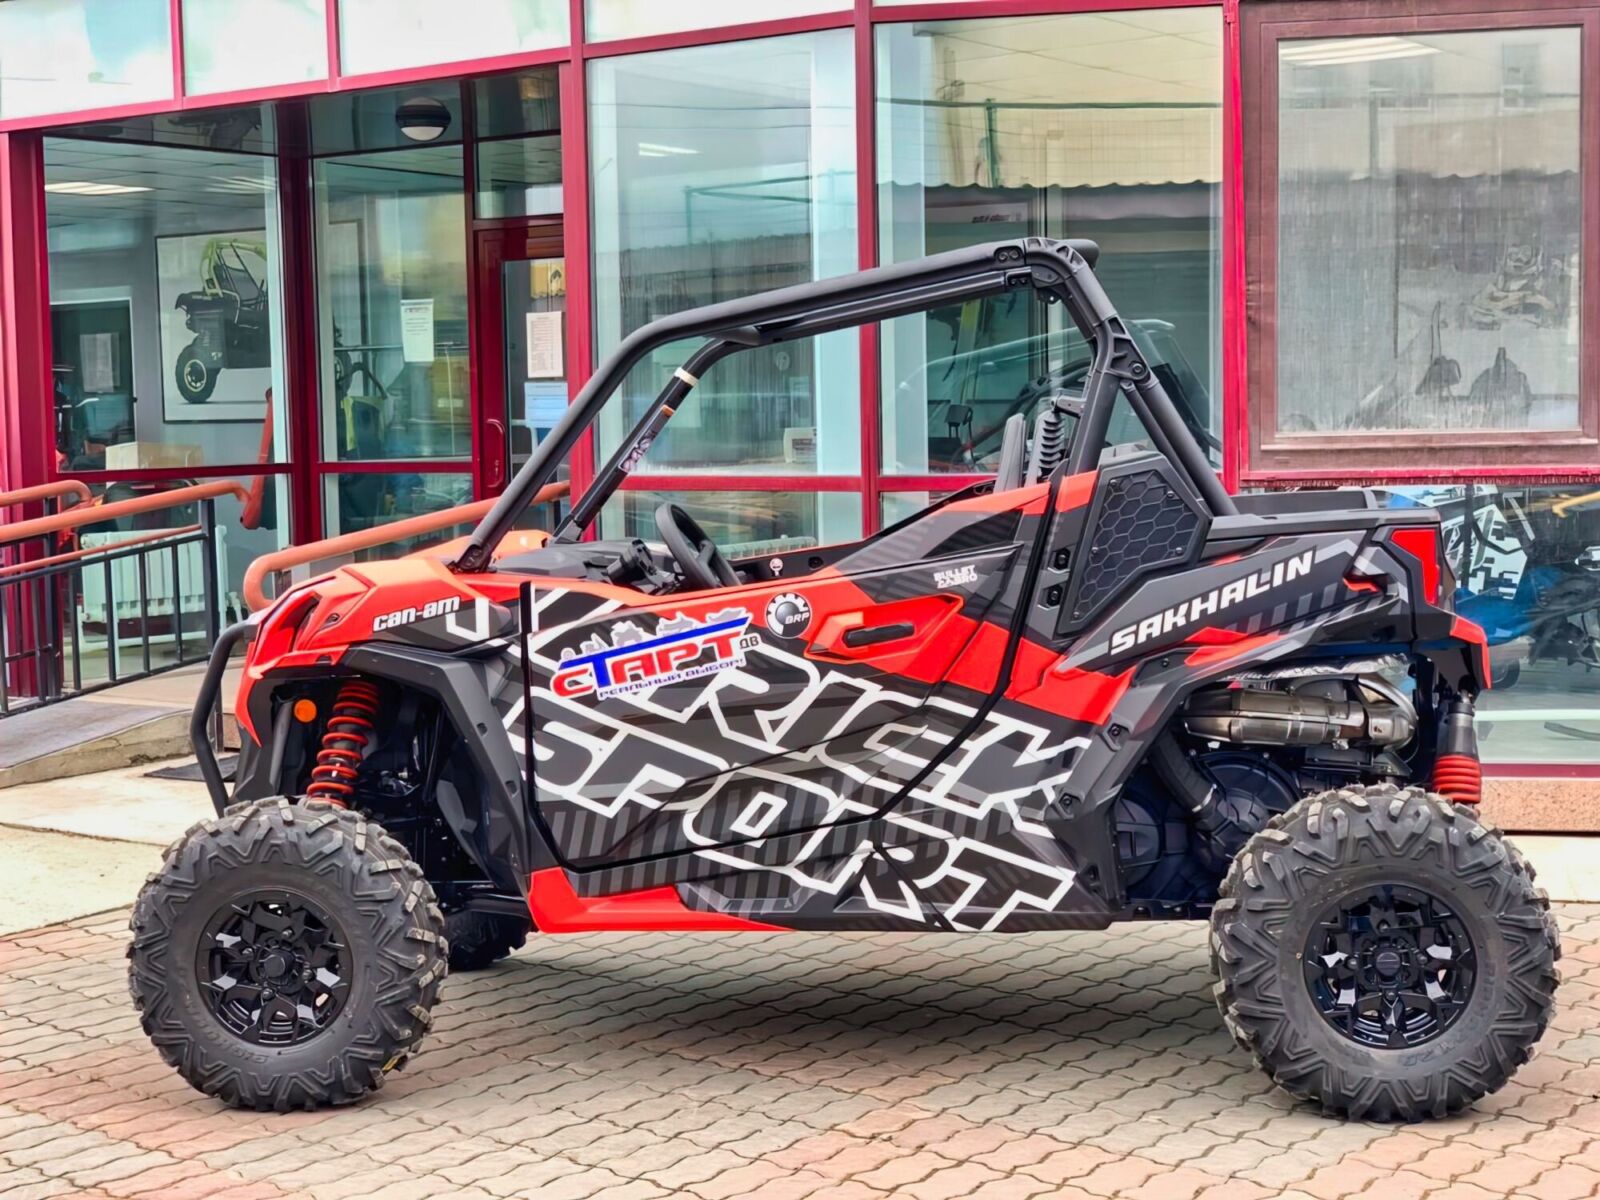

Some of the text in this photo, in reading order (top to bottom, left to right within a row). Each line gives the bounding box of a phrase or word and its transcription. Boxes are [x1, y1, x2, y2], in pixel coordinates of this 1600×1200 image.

[372, 595, 460, 632] can-am
[785, 612, 810, 625] BRP
[1110, 551, 1314, 656] SAKHALIN
[552, 616, 750, 698] СТАРТ
